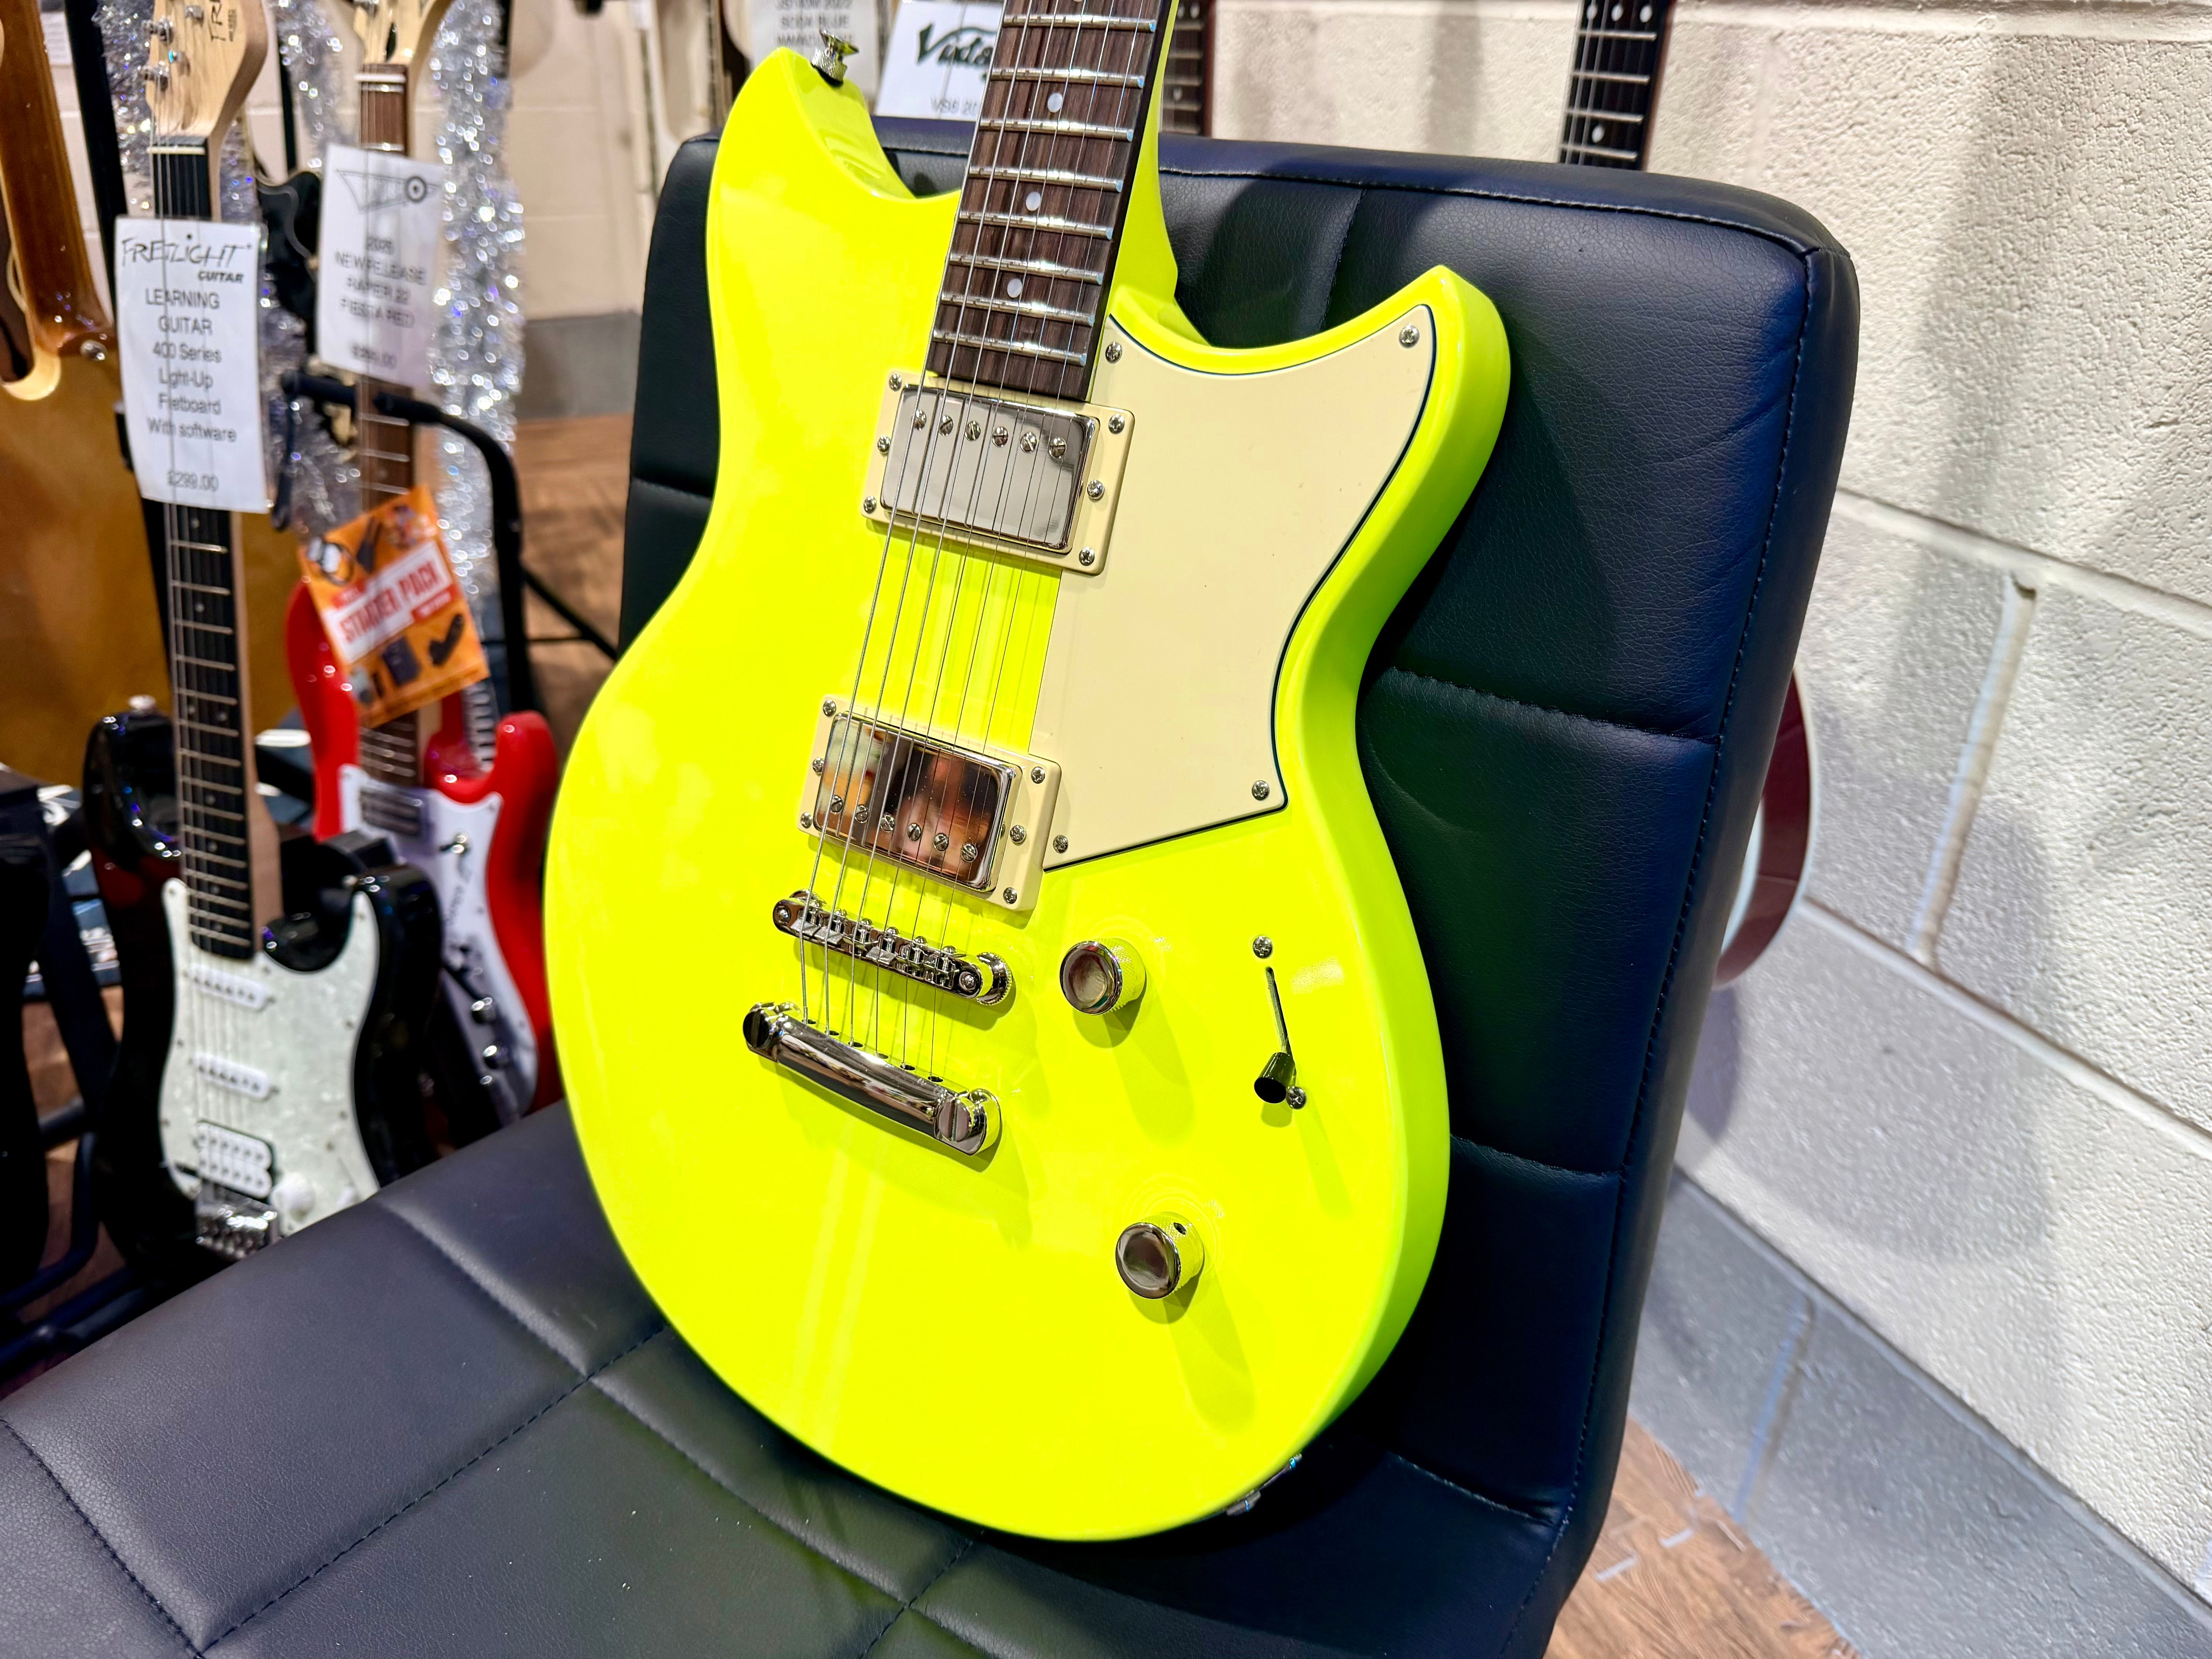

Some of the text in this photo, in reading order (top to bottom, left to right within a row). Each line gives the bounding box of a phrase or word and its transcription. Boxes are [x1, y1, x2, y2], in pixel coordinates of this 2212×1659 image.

[818, 14, 850, 28] BLUE
[198, 271, 244, 283] GUITAR
[334, 251, 428, 286] NEW RELEASE
[145, 288, 220, 309] LEARNING
[158, 315, 213, 335] GUITAR
[386, 307, 416, 328] RED
[153, 341, 222, 363] 400 Series
[158, 367, 214, 392] Light-Up
[158, 392, 222, 415] Fretboard
[146, 416, 237, 442] With software
[340, 587, 401, 644] STARTER
